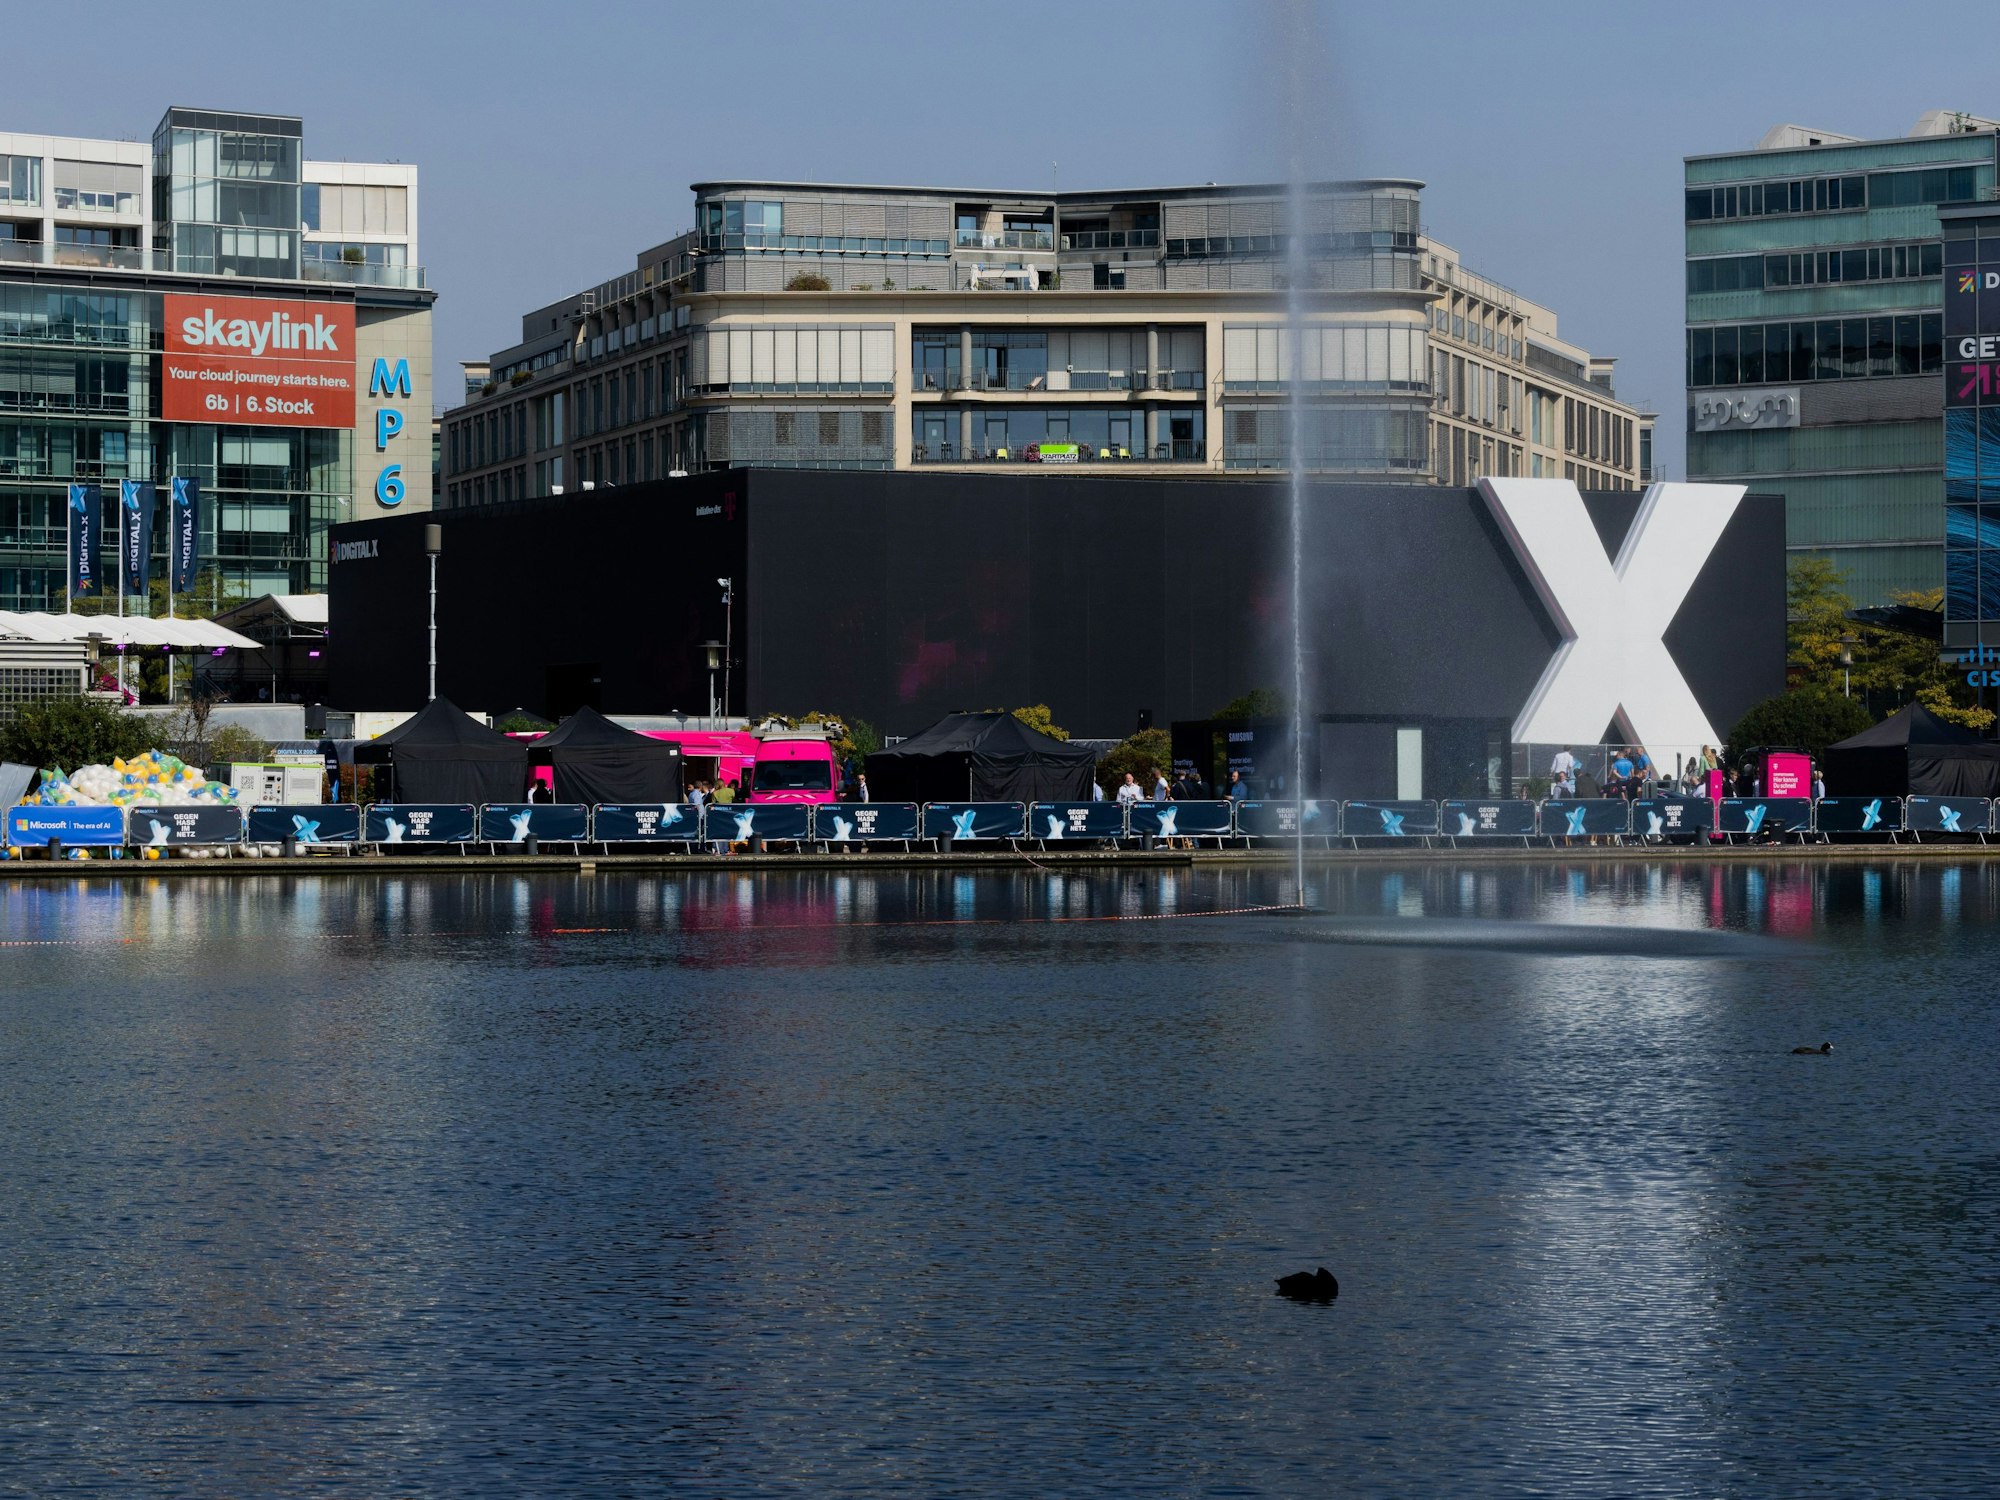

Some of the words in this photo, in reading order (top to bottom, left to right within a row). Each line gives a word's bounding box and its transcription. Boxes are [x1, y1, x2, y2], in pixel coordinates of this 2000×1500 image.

[182, 308, 338, 356] skaylink
[1959, 336, 2000, 358] GE
[169, 367, 197, 380] Your
[199, 369, 233, 382] cloud
[235, 370, 281, 386] journey
[283, 374, 317, 386] starts
[320, 374, 350, 388] here.
[206, 394, 228, 411] 6b
[246, 396, 262, 412] 6.
[265, 396, 314, 414] Stock
[82, 516, 88, 525] X
[132, 512, 141, 521] X
[183, 509, 191, 518] X
[80, 526, 90, 573] DIGITAL
[130, 523, 141, 571] DIGITAL
[183, 520, 192, 569] DIGITAL
[341, 540, 371, 560] DIGITAL
[372, 540, 378, 557] X
[1229, 732, 1253, 742] SAMSUNG
